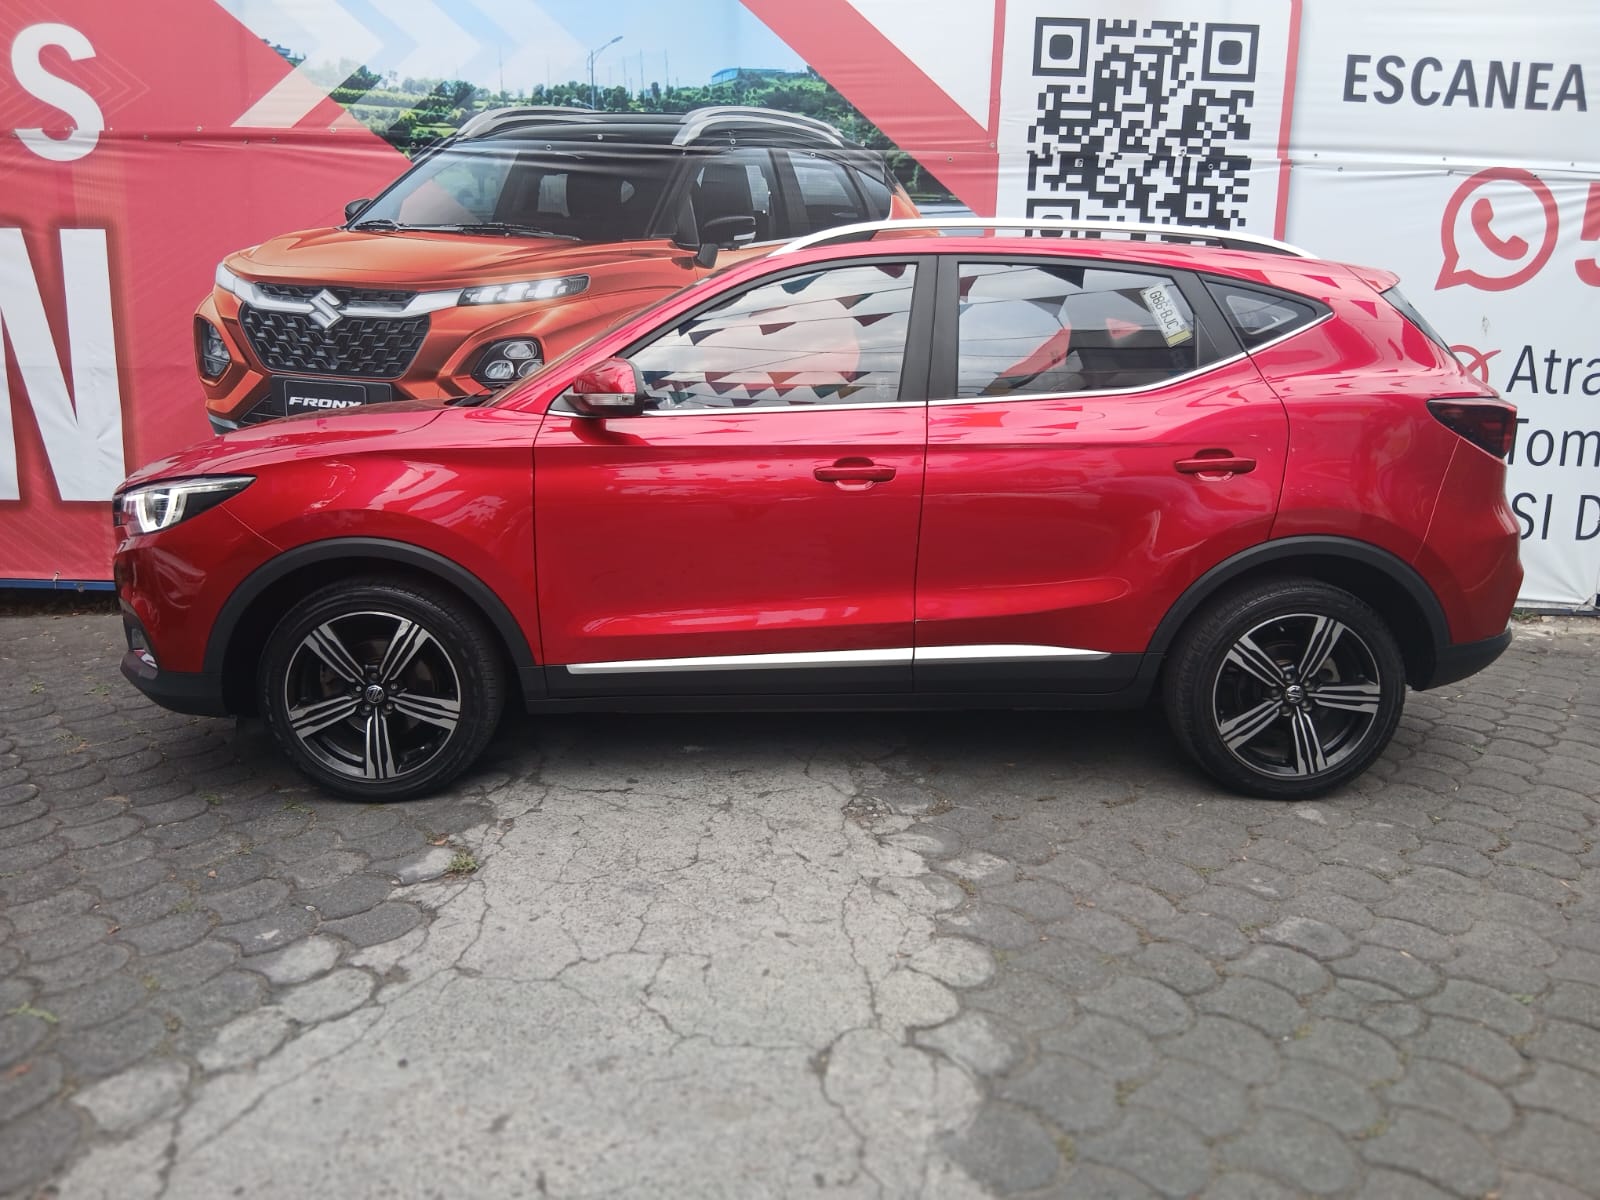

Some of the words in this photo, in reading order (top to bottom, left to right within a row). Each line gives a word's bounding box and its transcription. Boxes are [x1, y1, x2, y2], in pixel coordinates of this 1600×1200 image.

[10, 22, 105, 161] S
[1342, 54, 1588, 112] ESCANEA
[1505, 344, 1600, 396] Atra
[1507, 418, 1600, 467] Tom
[1511, 492, 1553, 541] SI
